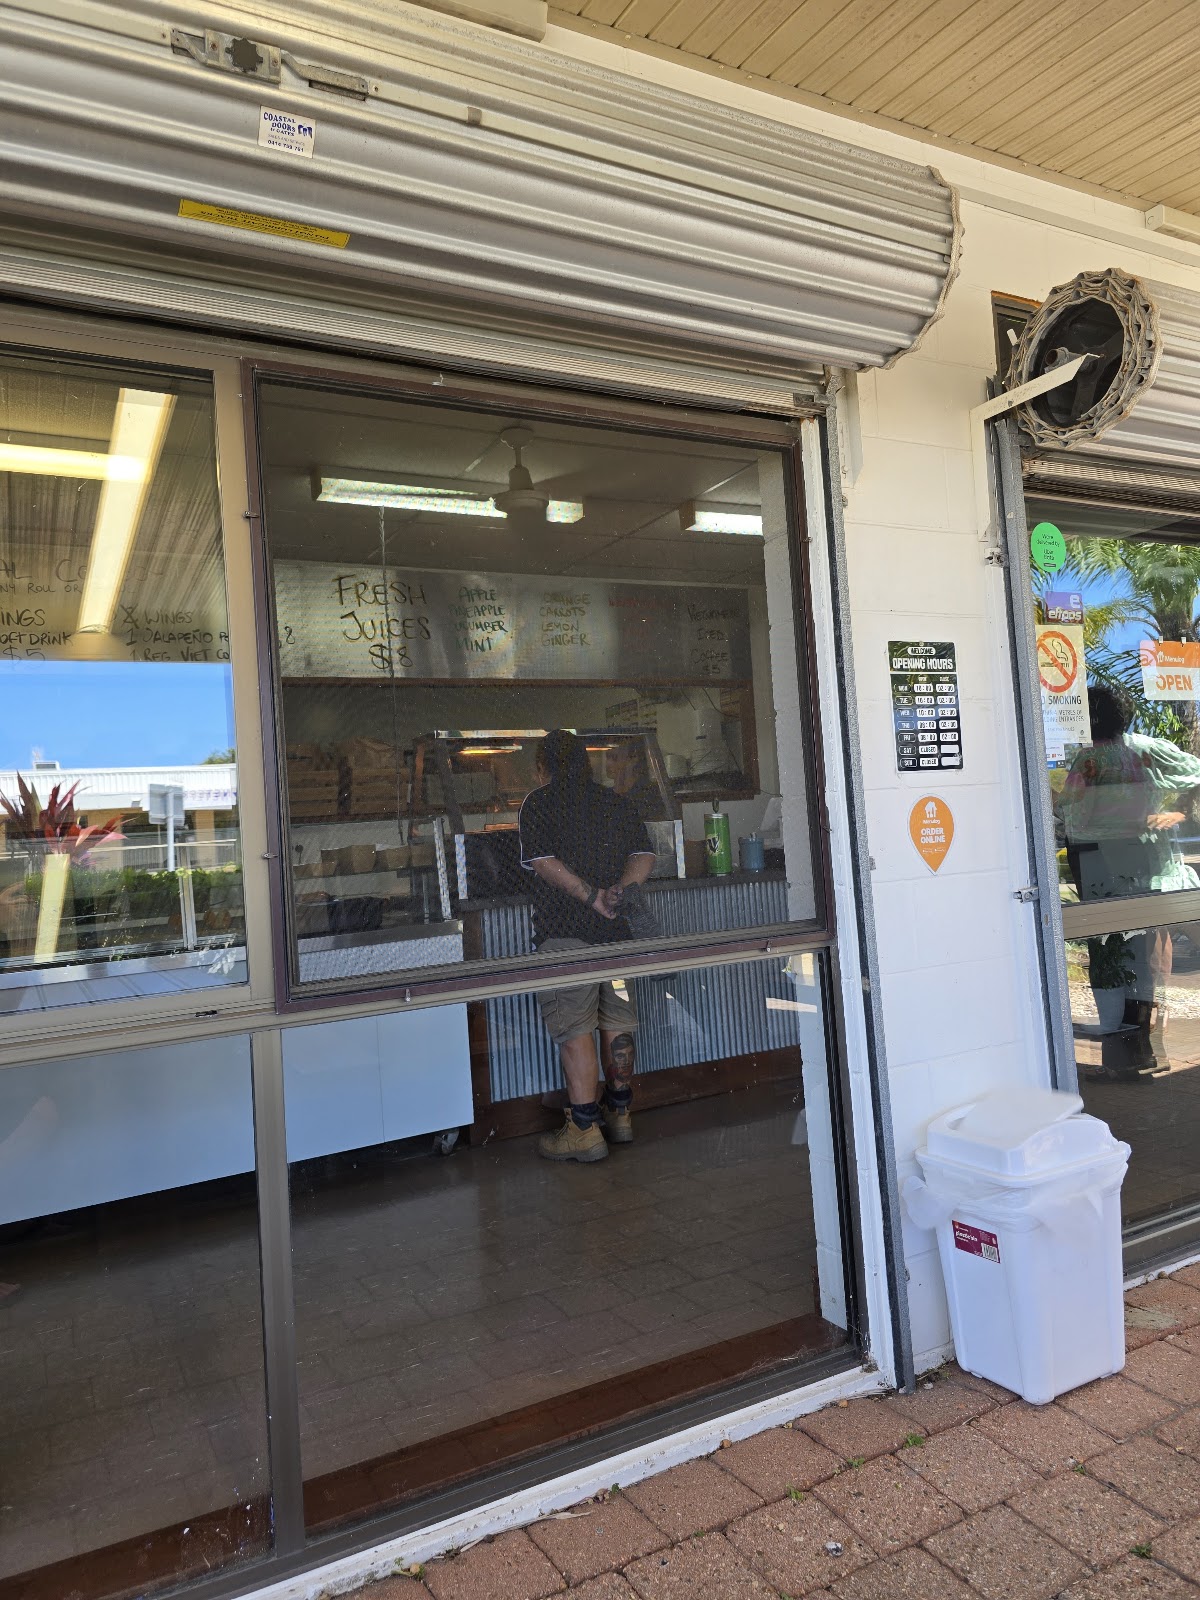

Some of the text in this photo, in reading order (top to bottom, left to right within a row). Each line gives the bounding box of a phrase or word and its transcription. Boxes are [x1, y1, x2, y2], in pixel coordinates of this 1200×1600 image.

[263, 111, 297, 124] COASTAL
[271, 121, 296, 133] DOORS
[0, 560, 32, 580] AL
[0, 582, 83, 595] NY ROLL OR
[332, 574, 427, 607] FRESH
[458, 586, 498, 602] APPLE
[0, 607, 46, 627] INGS
[144, 609, 193, 625] WINGS
[448, 604, 506, 619] PINEAPPLE
[539, 606, 586, 618] CARROTS
[1048, 606, 1082, 624] eftpos
[340, 610, 431, 642] JUICES
[541, 619, 580, 633] LEMON
[0, 631, 73, 647] OFT DRINK
[454, 636, 494, 653] MINT
[541, 633, 591, 647] GINGER
[180, 645, 212, 663] VIET
[368, 643, 414, 673] $8
[910, 647, 934, 655] WELCOME
[892, 657, 954, 670] OPENING HOURS
[1164, 655, 1185, 664] Menulog
[1155, 674, 1193, 691] OPEN
[1041, 695, 1046, 705] O
[1048, 695, 1082, 705] SMOKING
[920, 827, 944, 836] ORDER
[920, 835, 946, 844] ONLINE
